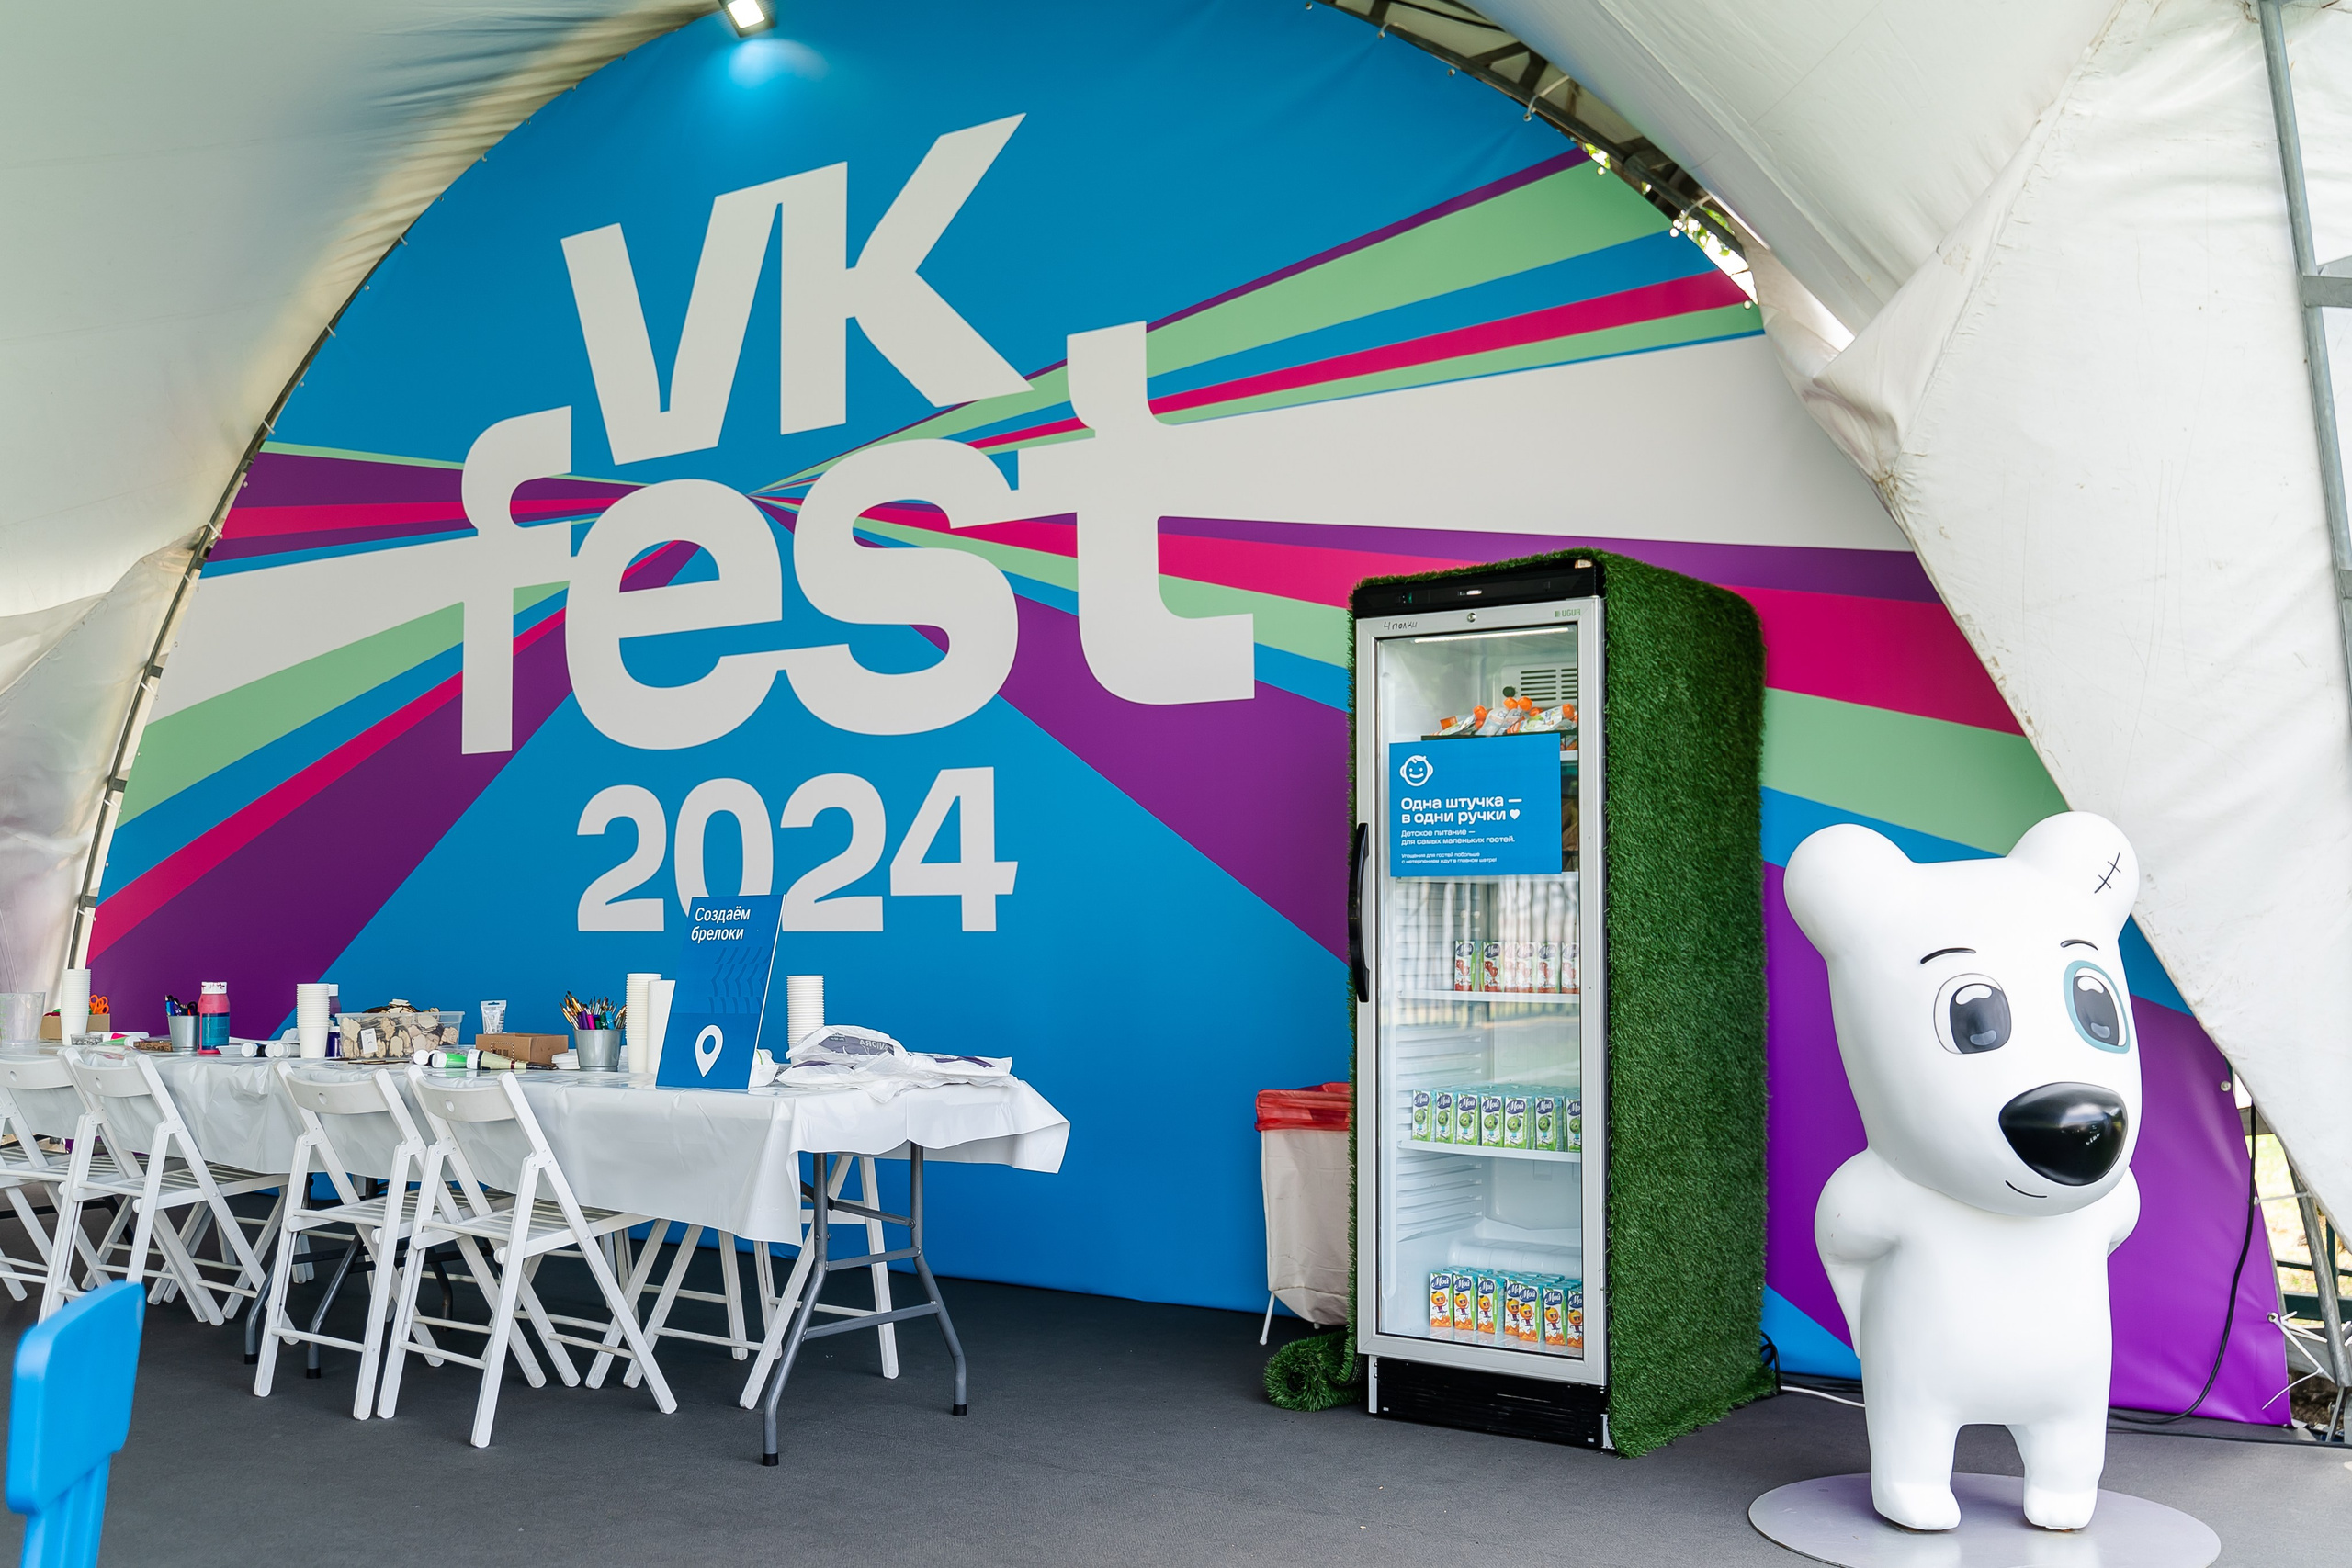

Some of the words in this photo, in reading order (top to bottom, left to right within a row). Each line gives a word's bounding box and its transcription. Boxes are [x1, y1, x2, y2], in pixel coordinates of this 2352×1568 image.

[560, 113, 1035, 466] VK
[461, 321, 1255, 754] fest
[1400, 797, 1442, 812] Одна
[1445, 795, 1504, 811] штучка
[1401, 813, 1411, 824] в
[1414, 812, 1454, 825] одни
[1457, 810, 1507, 825] ручки
[1401, 829, 1433, 838] Детское
[1434, 829, 1467, 837] питание
[1486, 835, 1516, 843] гостей.
[577, 766, 1018, 931] 2024
[695, 905, 752, 924] Создаём
[691, 926, 745, 944] брелоки
[1483, 1099, 1499, 1110] Мой
[1507, 1100, 1524, 1111] Мой
[1537, 1100, 1552, 1111] Мой
[1568, 1102, 1581, 1113] Мо
[1432, 1277, 1449, 1287] Мой
[1455, 1280, 1470, 1290] Мой
[1479, 1281, 1493, 1292] Мой
[1520, 1290, 1536, 1300] Мой
[1545, 1292, 1561, 1303] Мой
[1569, 1294, 1582, 1305] Мо
